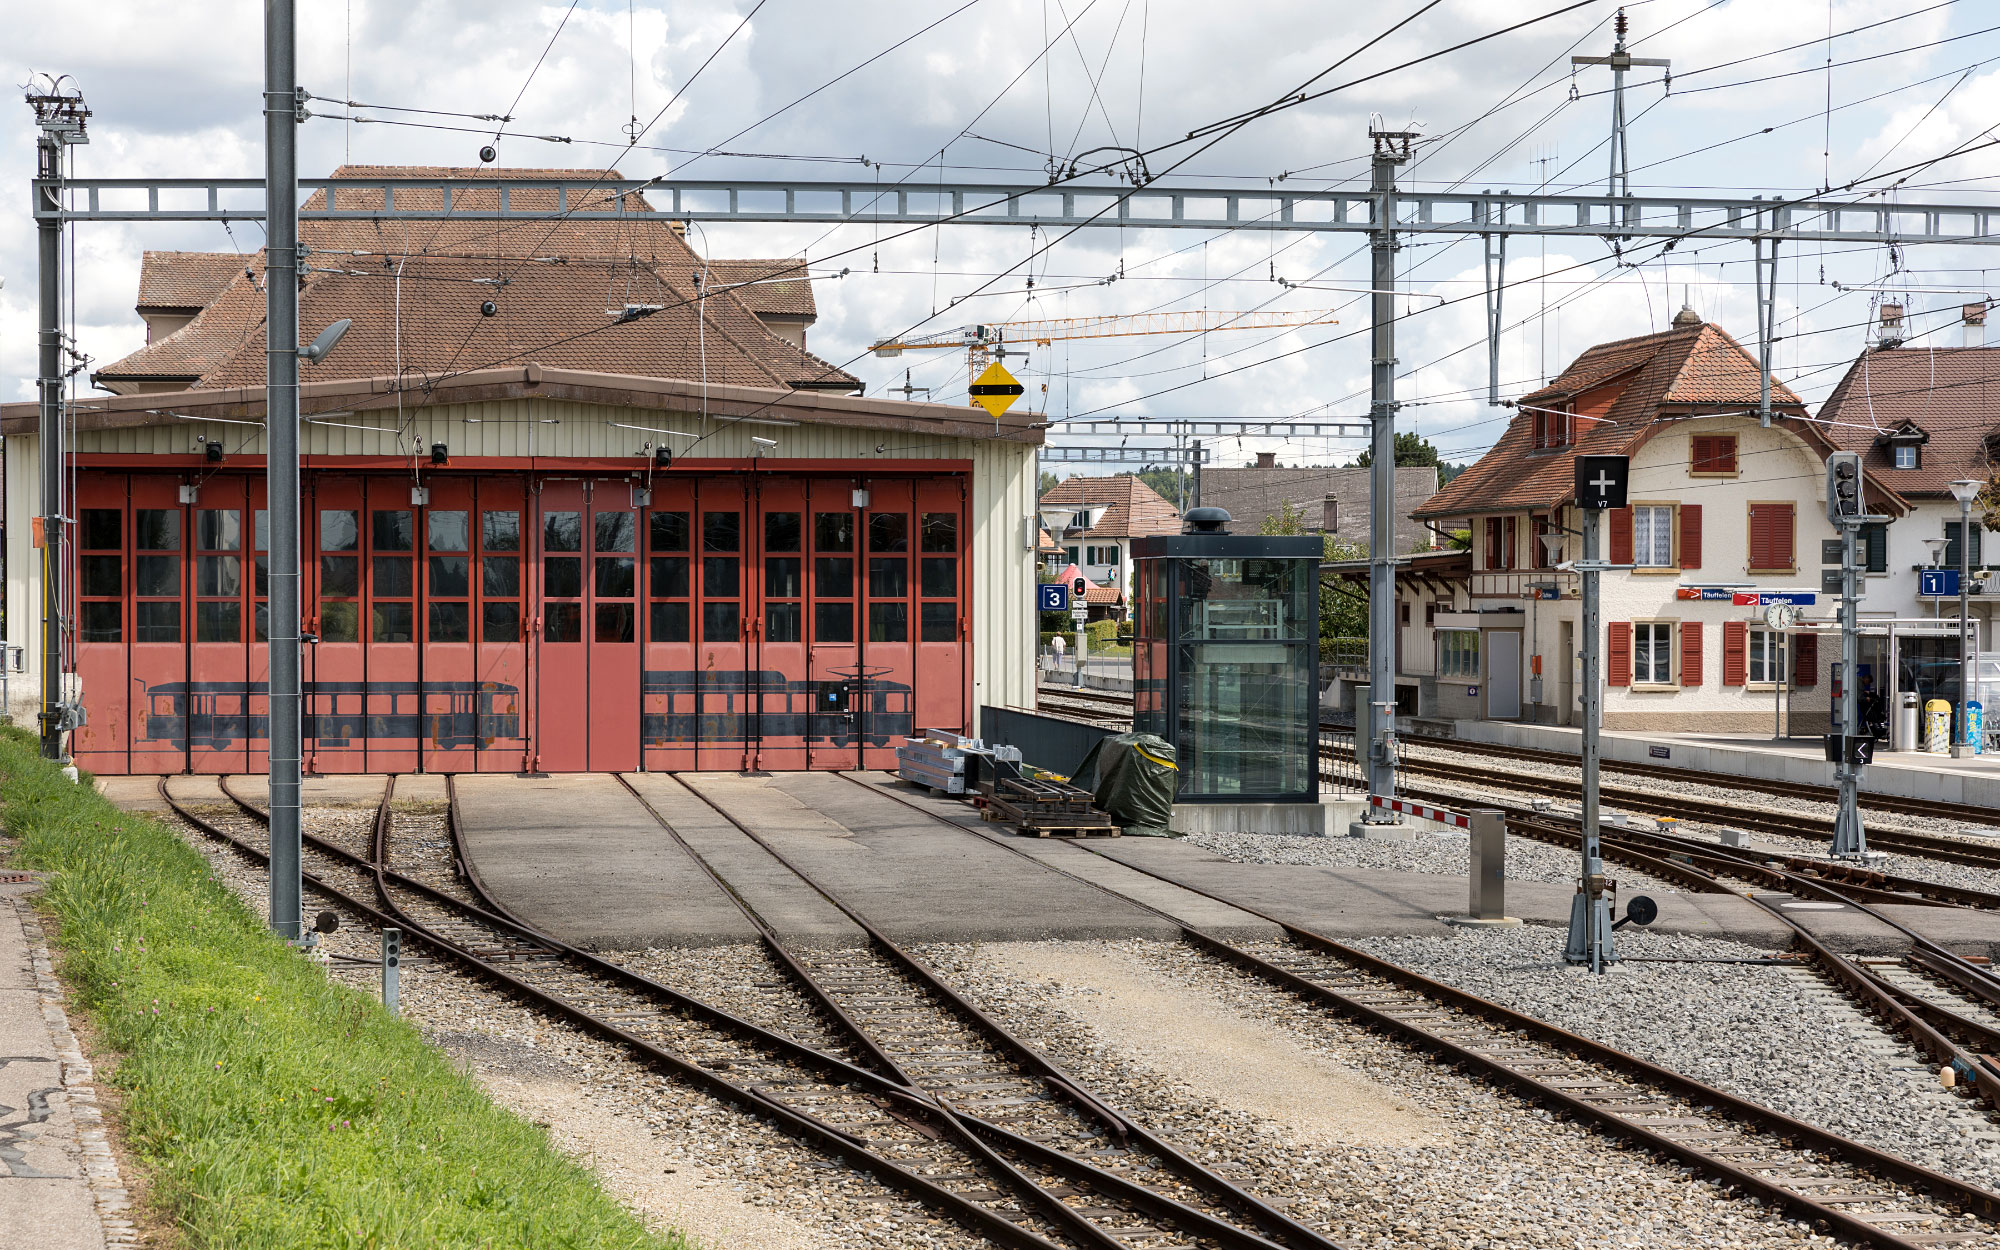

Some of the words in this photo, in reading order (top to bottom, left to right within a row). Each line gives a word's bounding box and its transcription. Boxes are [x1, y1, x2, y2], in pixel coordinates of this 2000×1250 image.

[1597, 500, 1608, 508] V7
[1930, 578, 1936, 592] 1
[1049, 592, 1060, 607] 3
